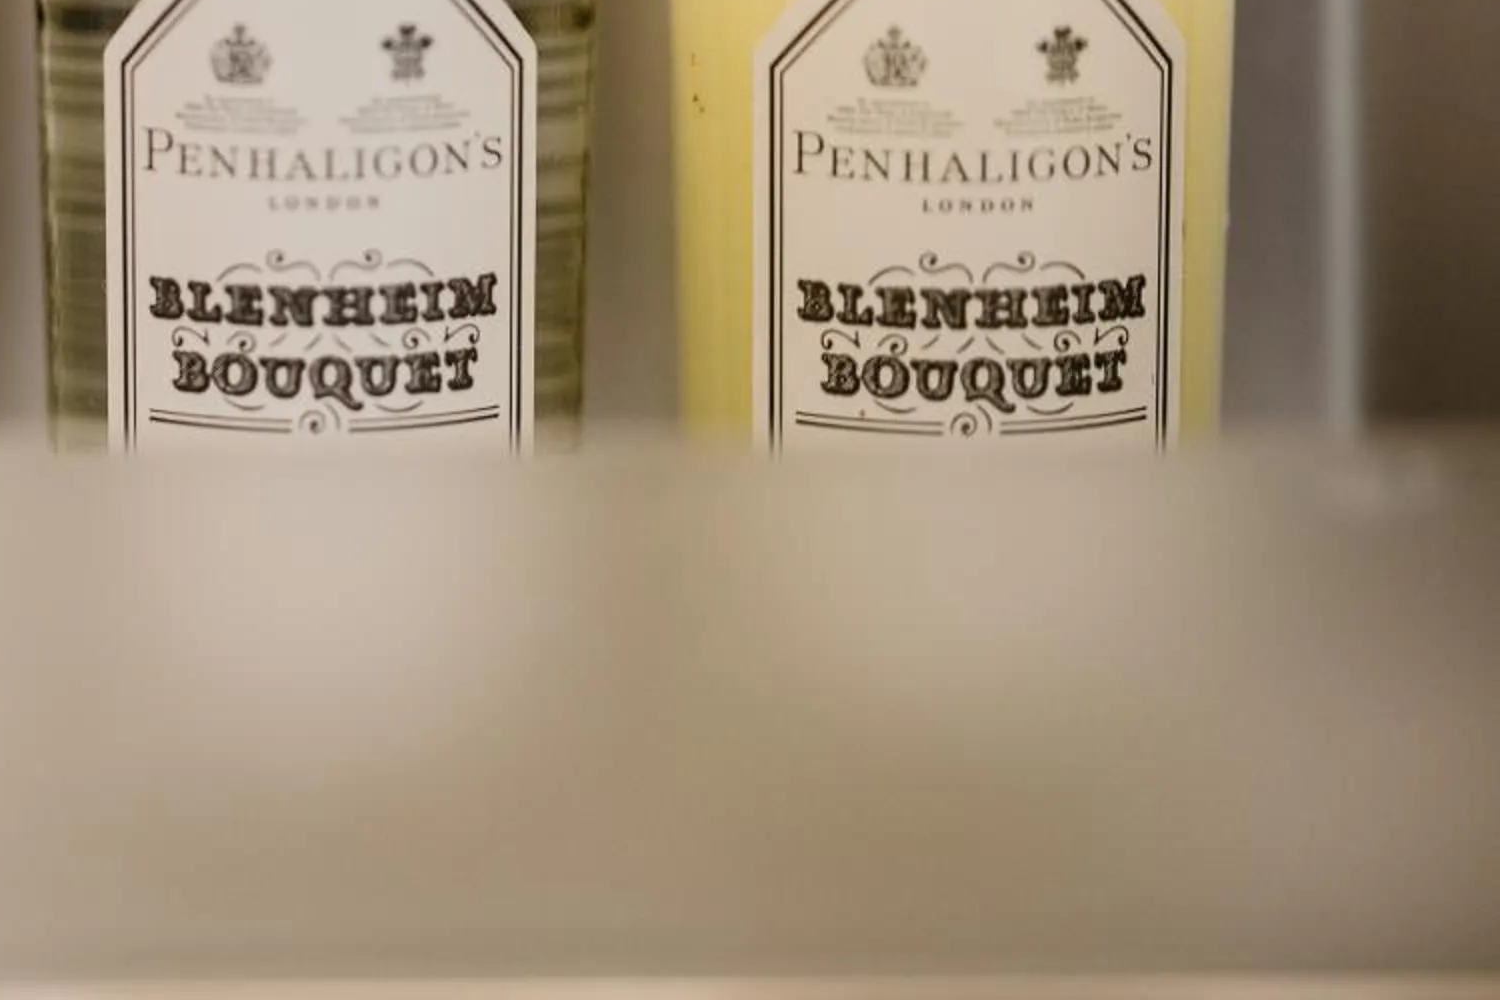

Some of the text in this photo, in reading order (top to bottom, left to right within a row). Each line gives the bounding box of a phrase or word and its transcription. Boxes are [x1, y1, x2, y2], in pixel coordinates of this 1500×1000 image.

[143, 127, 502, 181] PENHALIGON'S
[793, 131, 1152, 183] PENHALIGON'S
[922, 198, 1035, 214] LONDON
[150, 273, 498, 326] BLENHEIM
[798, 275, 1146, 330] BLENHEIM
[172, 348, 479, 411] BOUQUET
[820, 350, 1127, 413] BOUQUET
